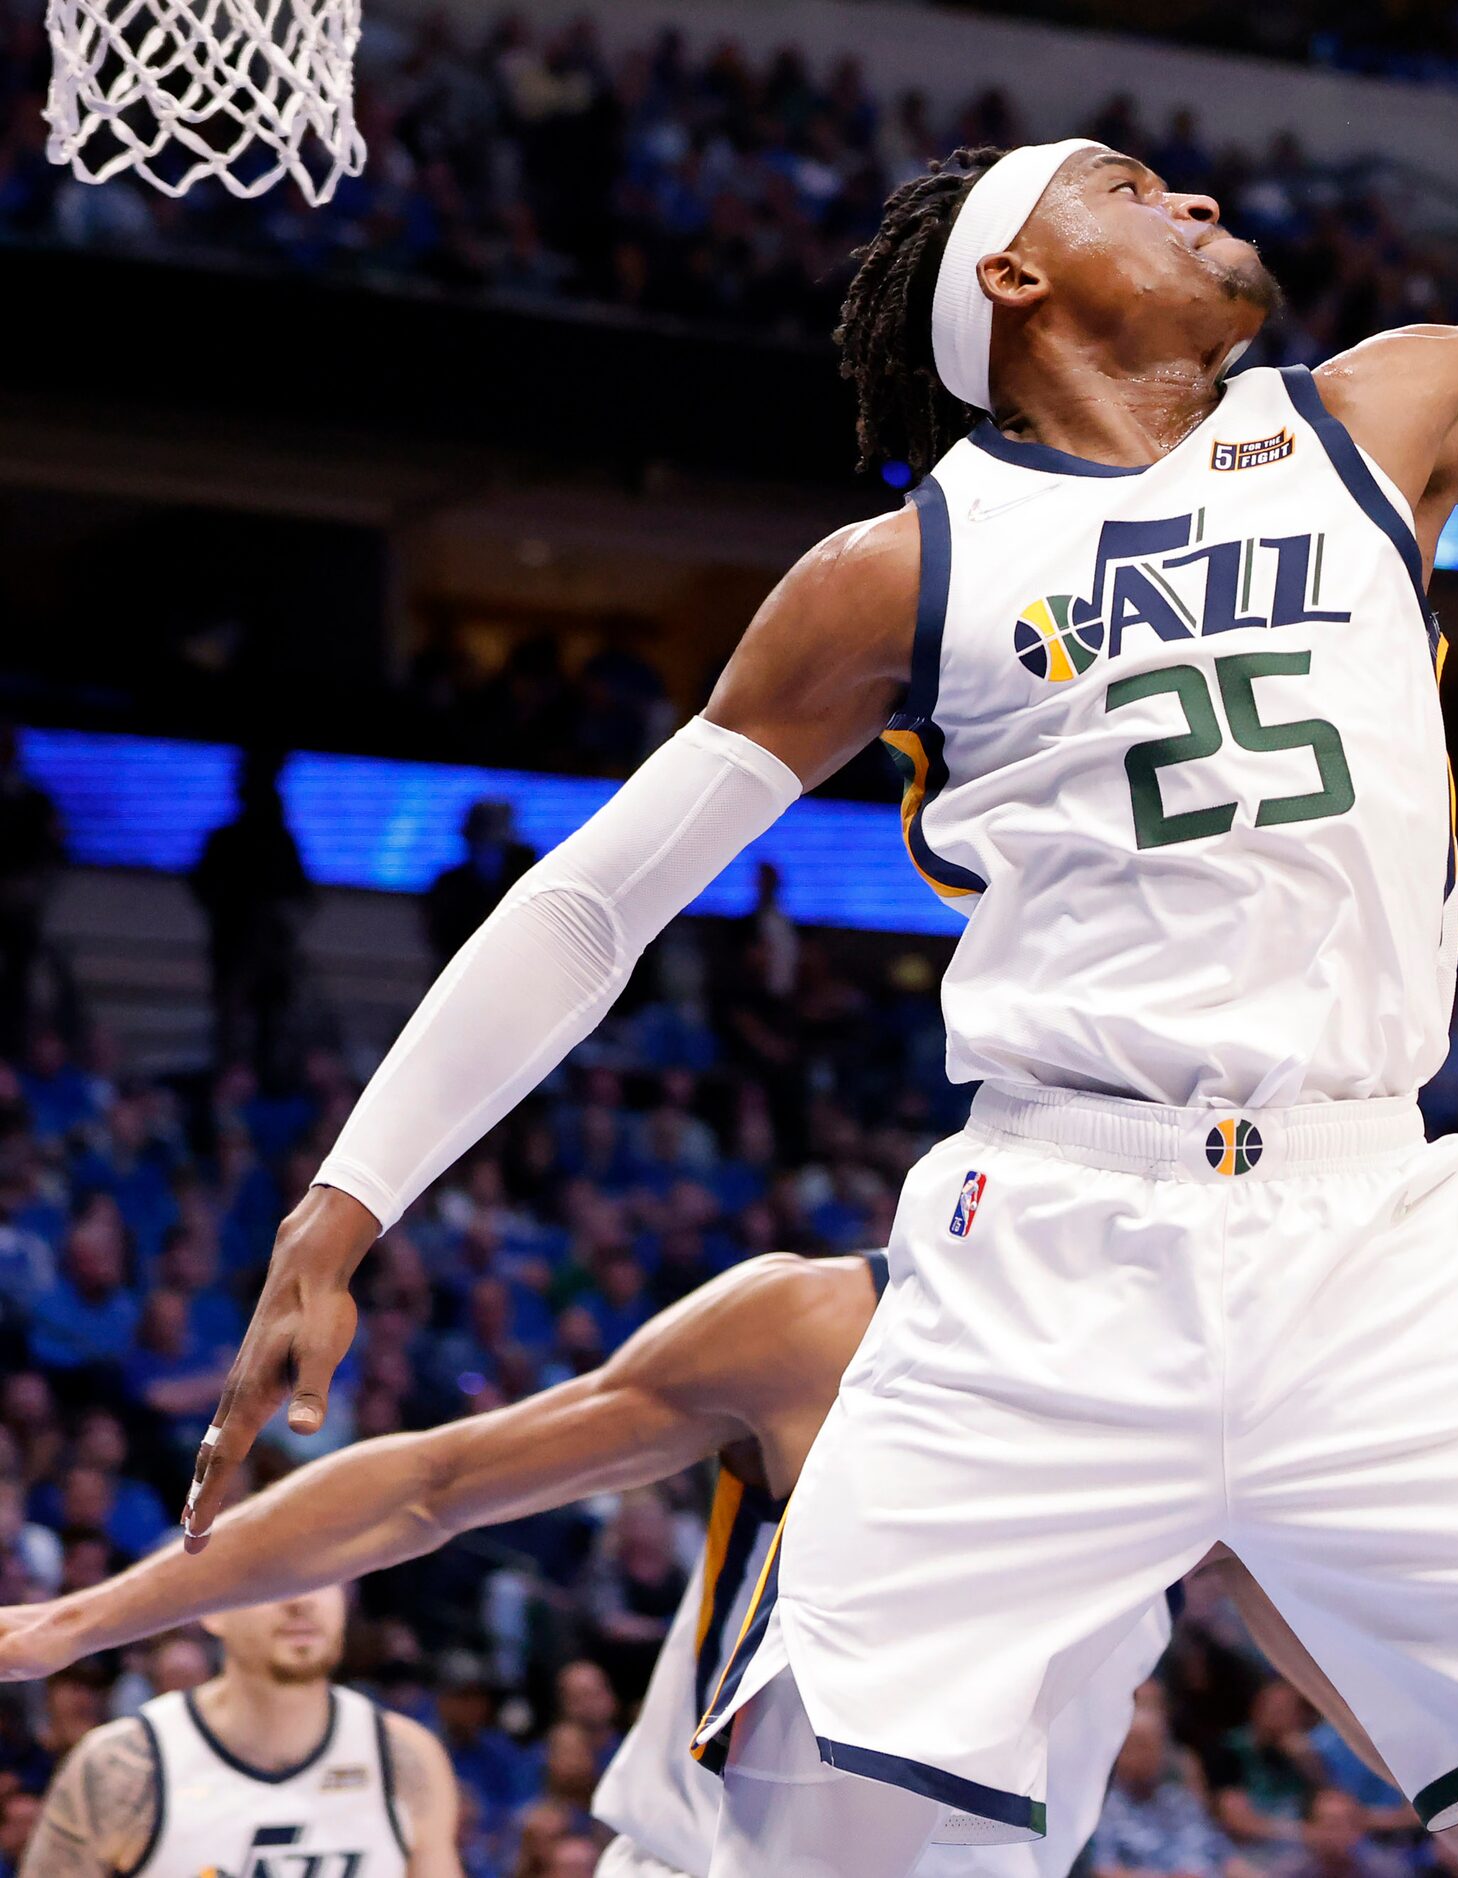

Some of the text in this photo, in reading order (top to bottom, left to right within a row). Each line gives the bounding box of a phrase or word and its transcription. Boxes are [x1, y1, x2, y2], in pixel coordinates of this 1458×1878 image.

[1215, 444, 1233, 470] 5
[1241, 443, 1290, 468] FIGHT
[1243, 436, 1281, 452] FOR THE
[1014, 507, 1352, 682] JAZZ
[1105, 650, 1356, 850] 25
